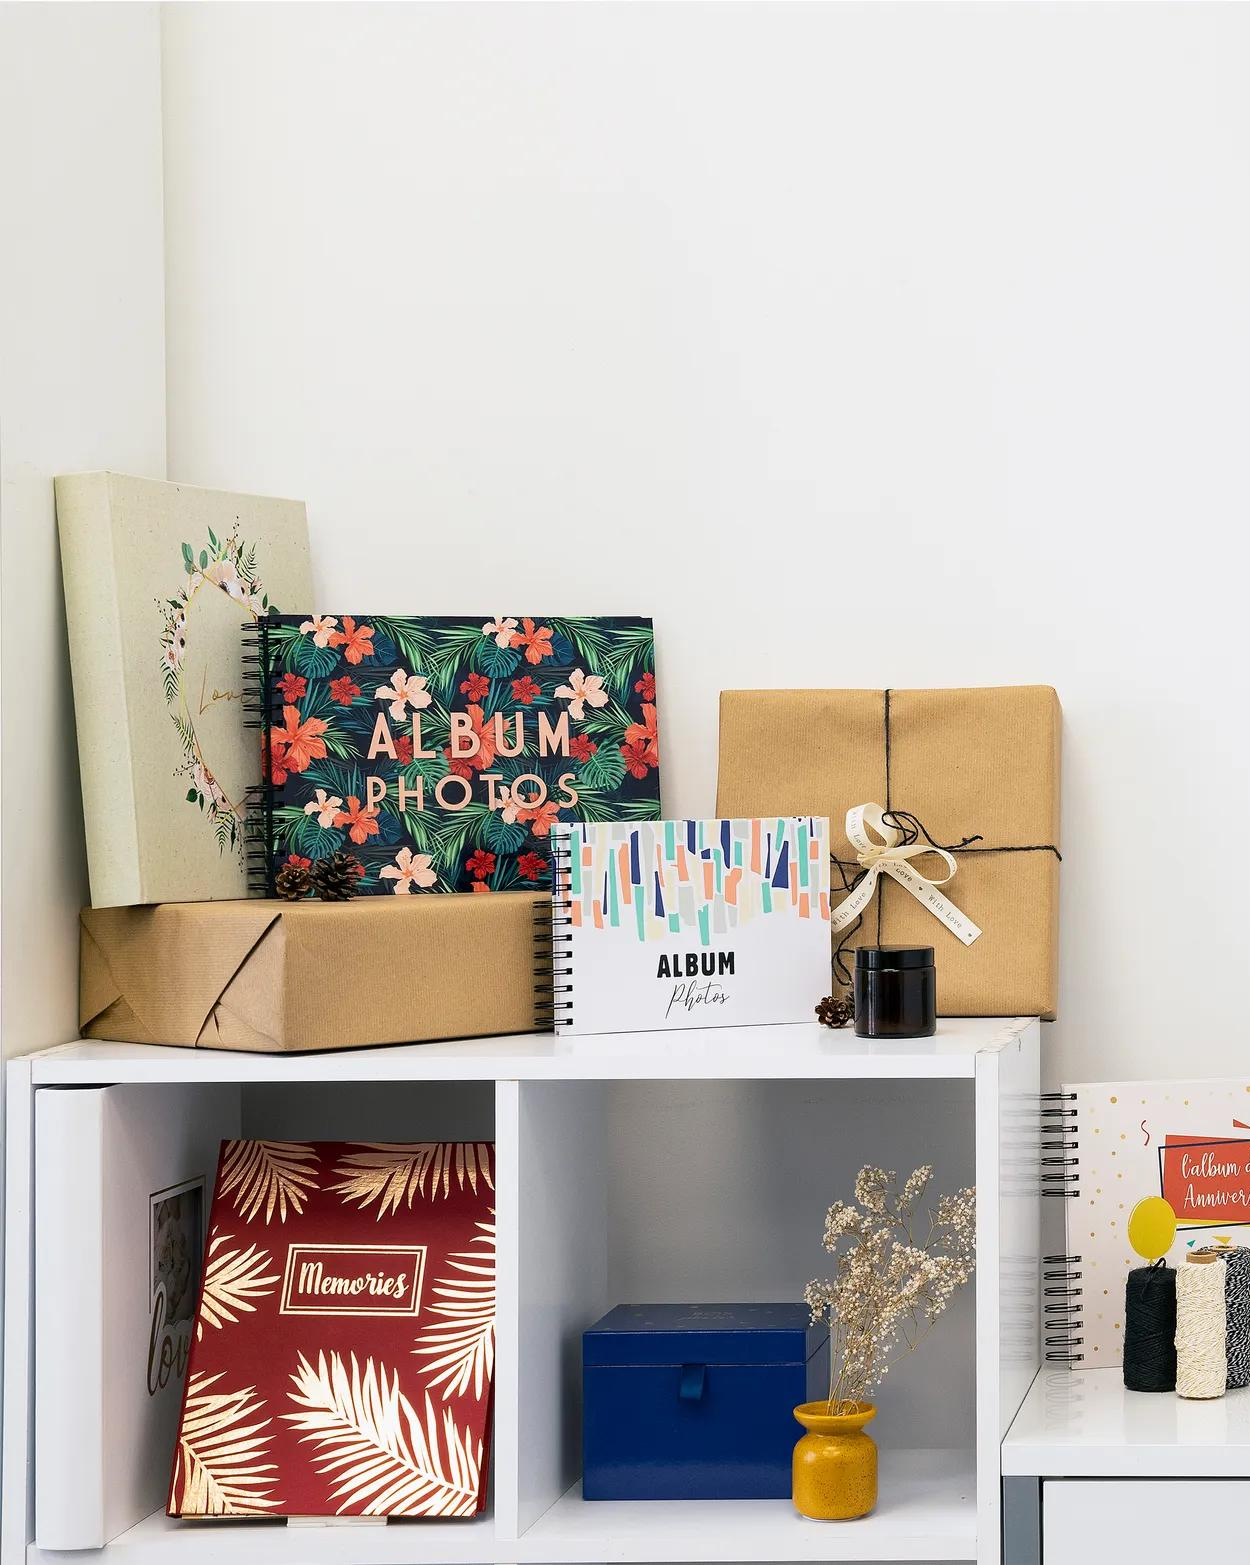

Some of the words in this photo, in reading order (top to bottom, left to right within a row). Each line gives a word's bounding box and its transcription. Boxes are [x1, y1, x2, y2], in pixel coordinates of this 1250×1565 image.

[367, 711, 571, 760] ALBUM
[366, 772, 579, 812] PHOTOS
[896, 867, 913, 883] Love
[831, 911, 850, 926] With
[850, 891, 866, 910] Love
[928, 894, 945, 911] With
[945, 911, 963, 929] Love
[656, 951, 735, 979] ALBUM
[665, 979, 730, 1019] Photos
[1181, 1151, 1241, 1179] l'album
[298, 1261, 410, 1299] Memories
[147, 1291, 189, 1397] lov
